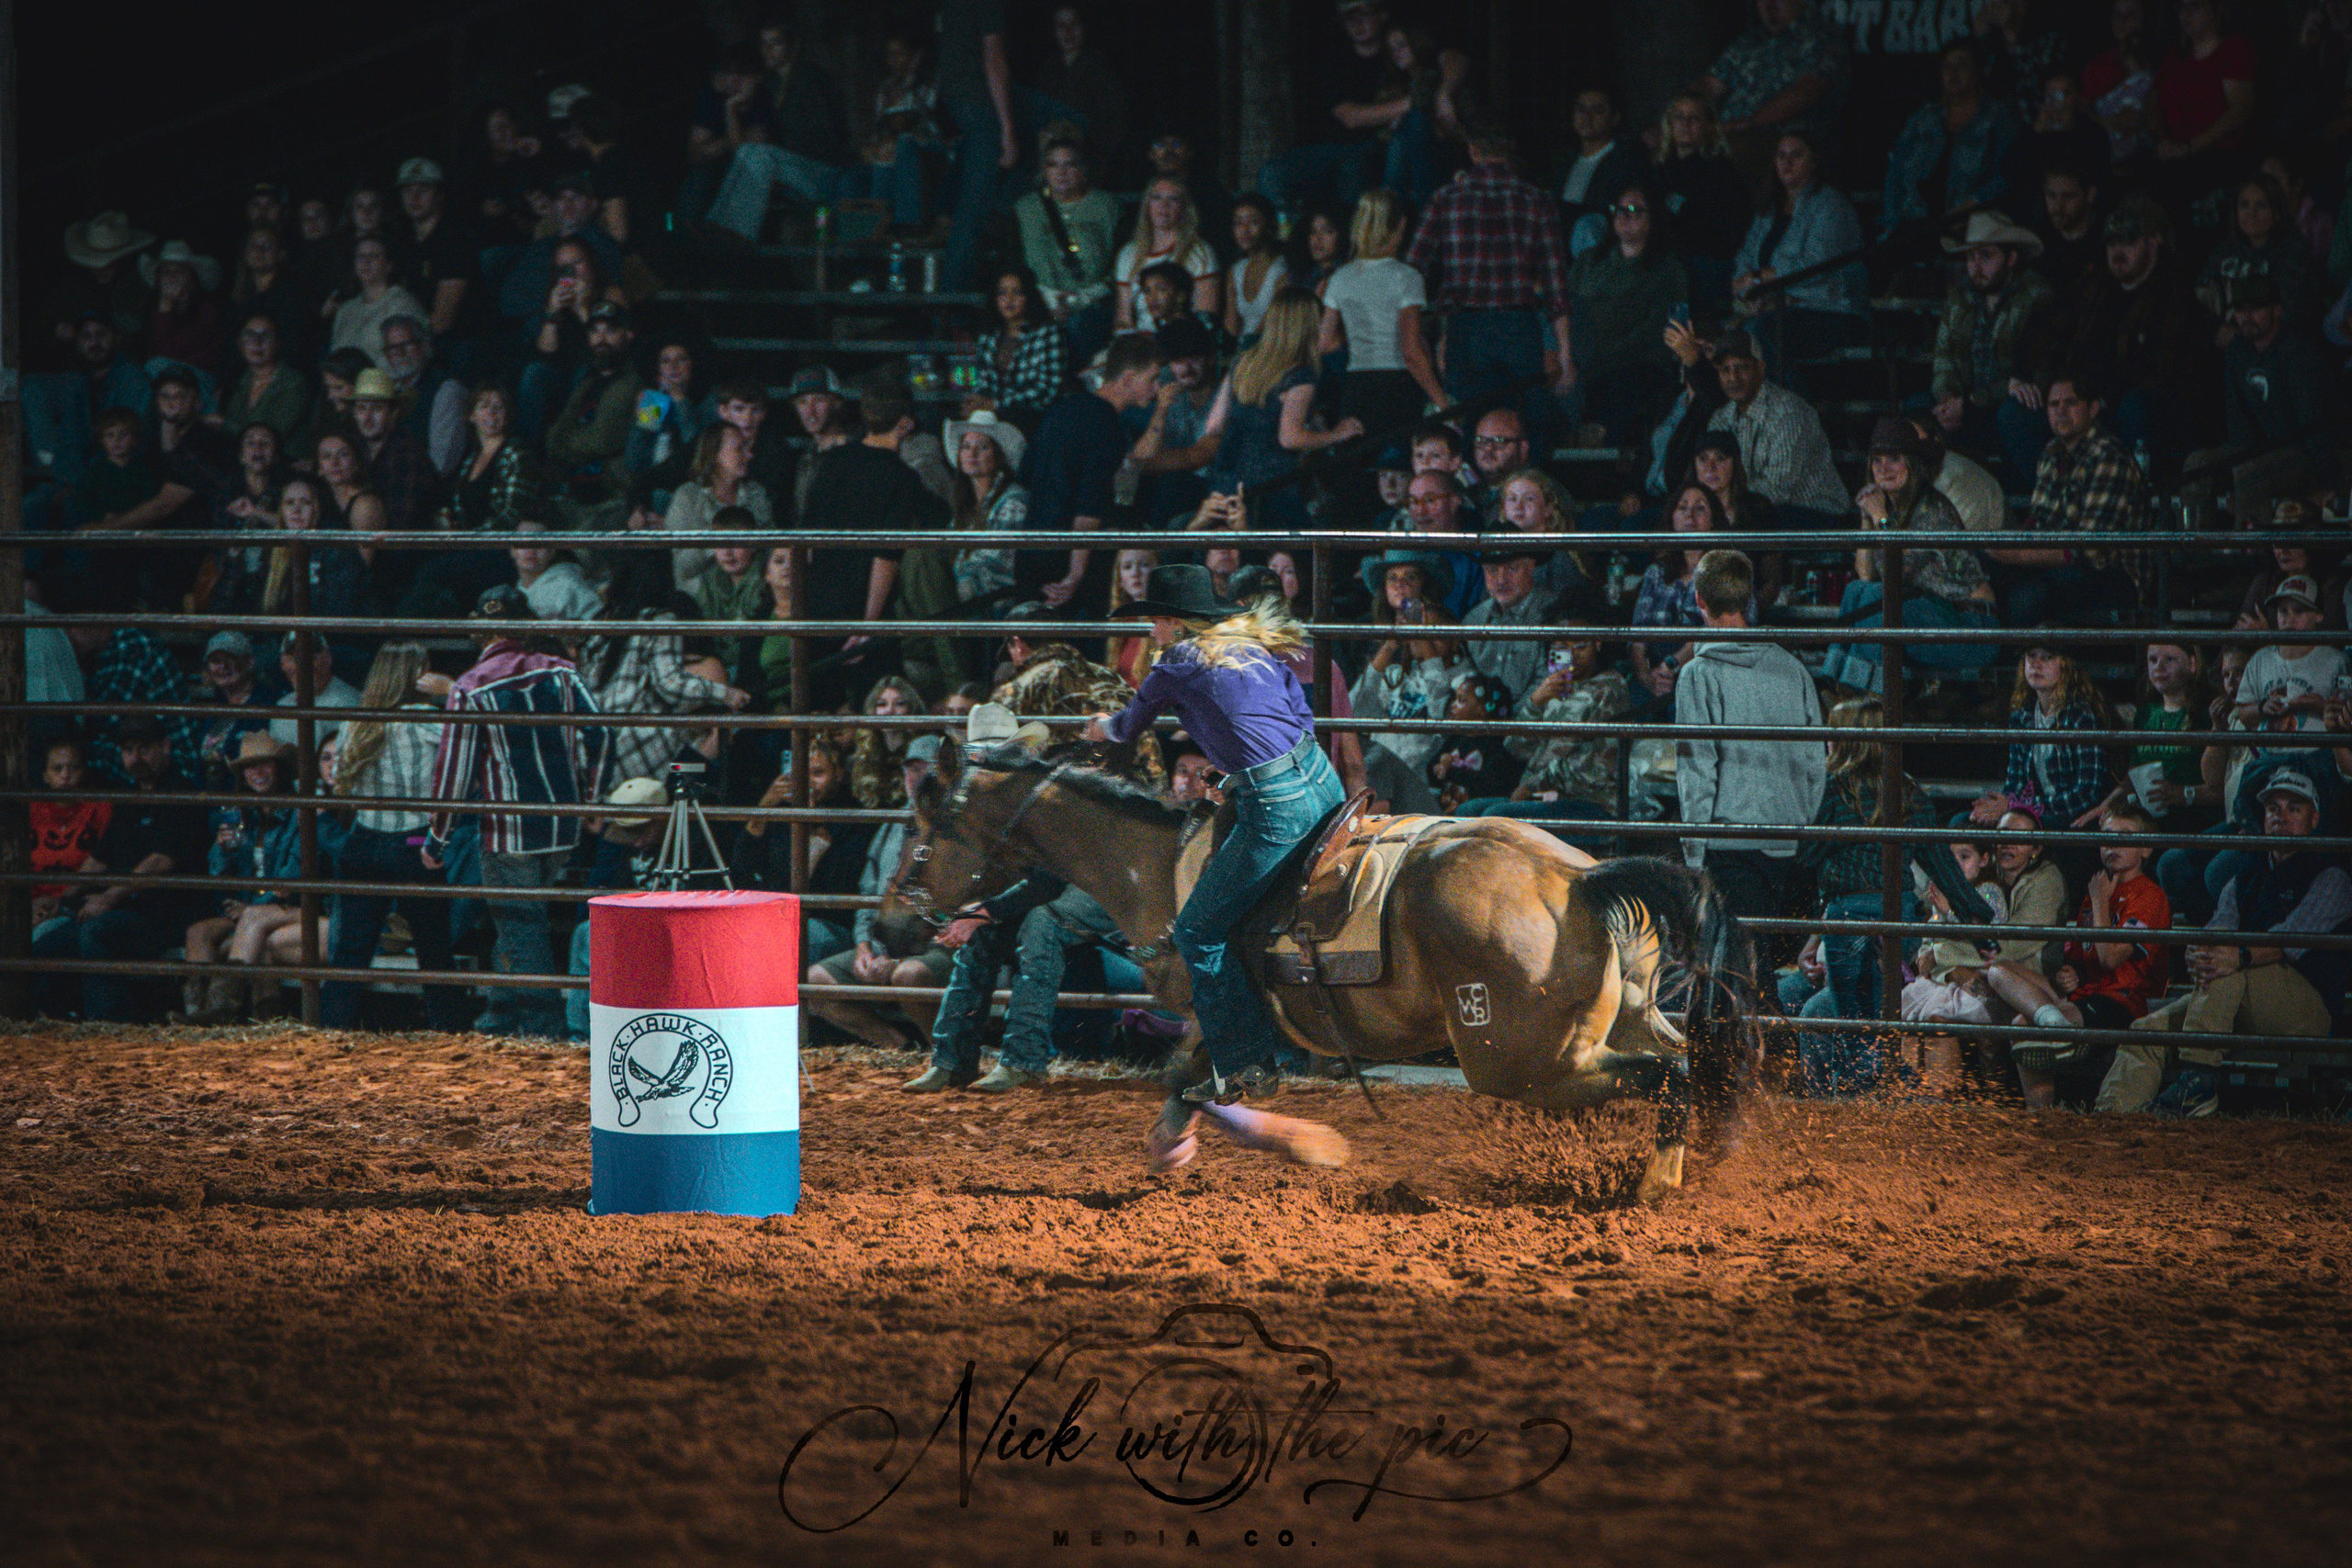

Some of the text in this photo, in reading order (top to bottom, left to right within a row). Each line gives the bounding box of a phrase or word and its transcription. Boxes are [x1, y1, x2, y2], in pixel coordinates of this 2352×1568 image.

[612, 1017, 729, 1101] BLACK HAWK RANCH
